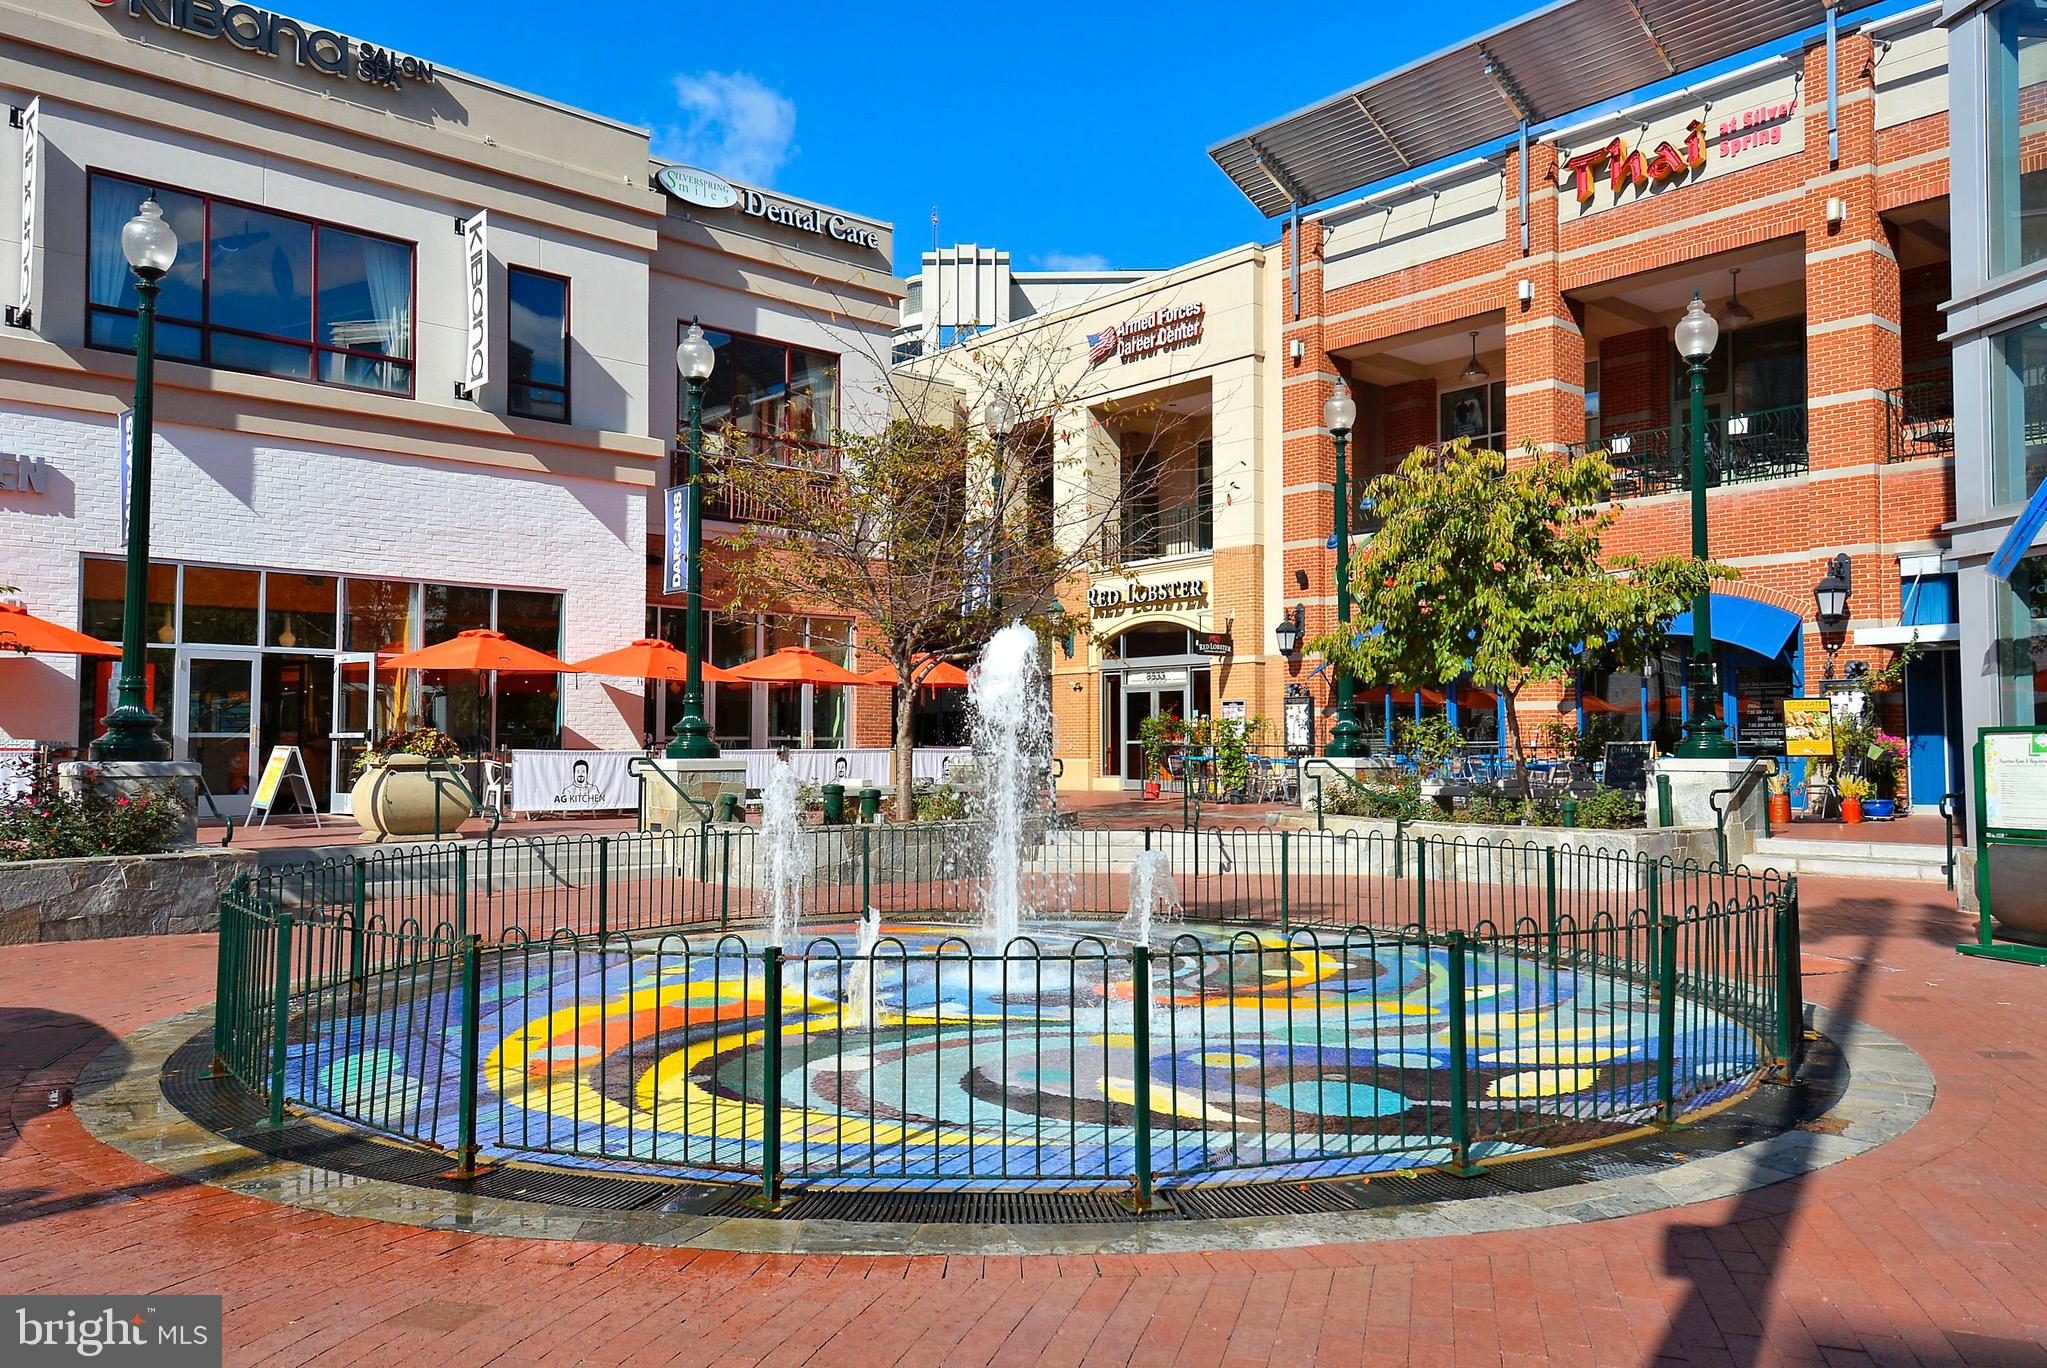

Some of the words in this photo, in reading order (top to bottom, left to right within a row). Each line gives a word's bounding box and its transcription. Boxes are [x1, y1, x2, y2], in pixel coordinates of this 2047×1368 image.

[359, 42, 434, 83] SALON
[1719, 116, 1737, 137] at
[1743, 100, 1799, 131] Silver
[1719, 126, 1782, 158] Spring
[1564, 119, 1707, 203] Thai
[743, 188, 823, 235] Dental
[827, 214, 880, 250] Care
[1117, 310, 1157, 338] Armed
[1157, 302, 1203, 326] Forces
[1117, 334, 1157, 357] Career
[1157, 319, 1203, 347] Center
[672, 490, 683, 589] DARCARS
[1087, 588, 1121, 608] RED
[1126, 579, 1205, 605] LOBSTER
[553, 794, 567, 804] AG
[569, 794, 606, 803] KITCHEN
